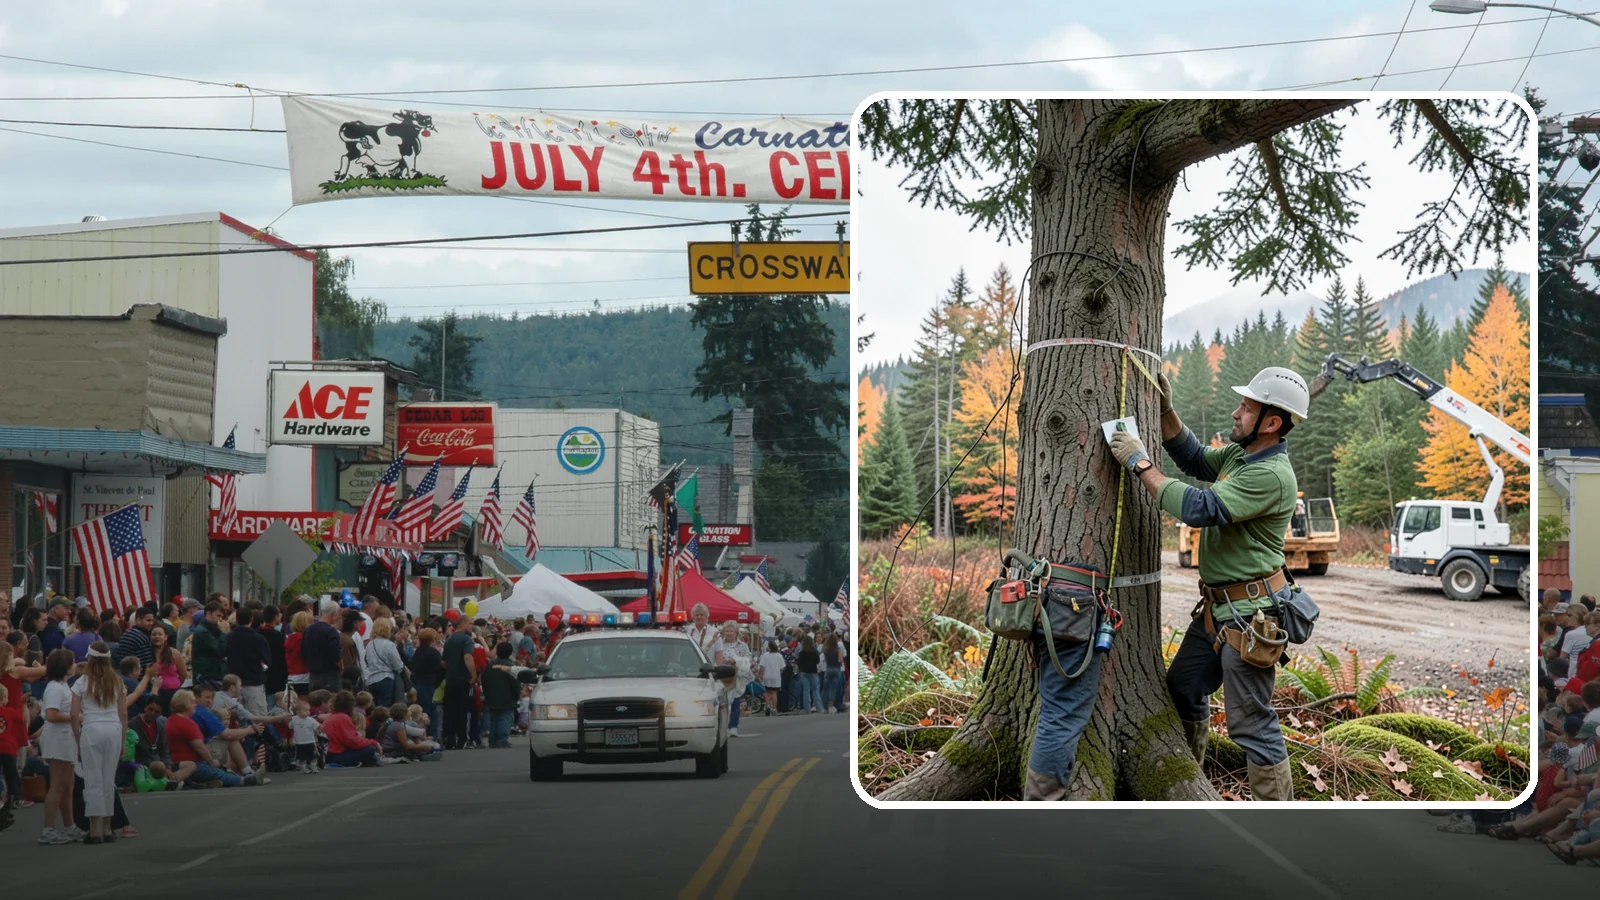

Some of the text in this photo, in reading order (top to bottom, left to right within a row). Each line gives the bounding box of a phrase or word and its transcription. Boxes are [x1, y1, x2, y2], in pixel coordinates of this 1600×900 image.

[695, 121, 850, 149] Carnat
[481, 141, 605, 192] JULY
[632, 149, 746, 198] 4th.
[697, 254, 850, 280] CROSSWA
[282, 380, 373, 420] ACE
[405, 409, 485, 422] CEDAR LOG
[283, 421, 371, 436] Hardware
[353, 466, 385, 480] Simpl
[83, 484, 155, 495] St. Vincent de Paul
[688, 526, 741, 535] CRNATION
[699, 535, 730, 543] GLASS
